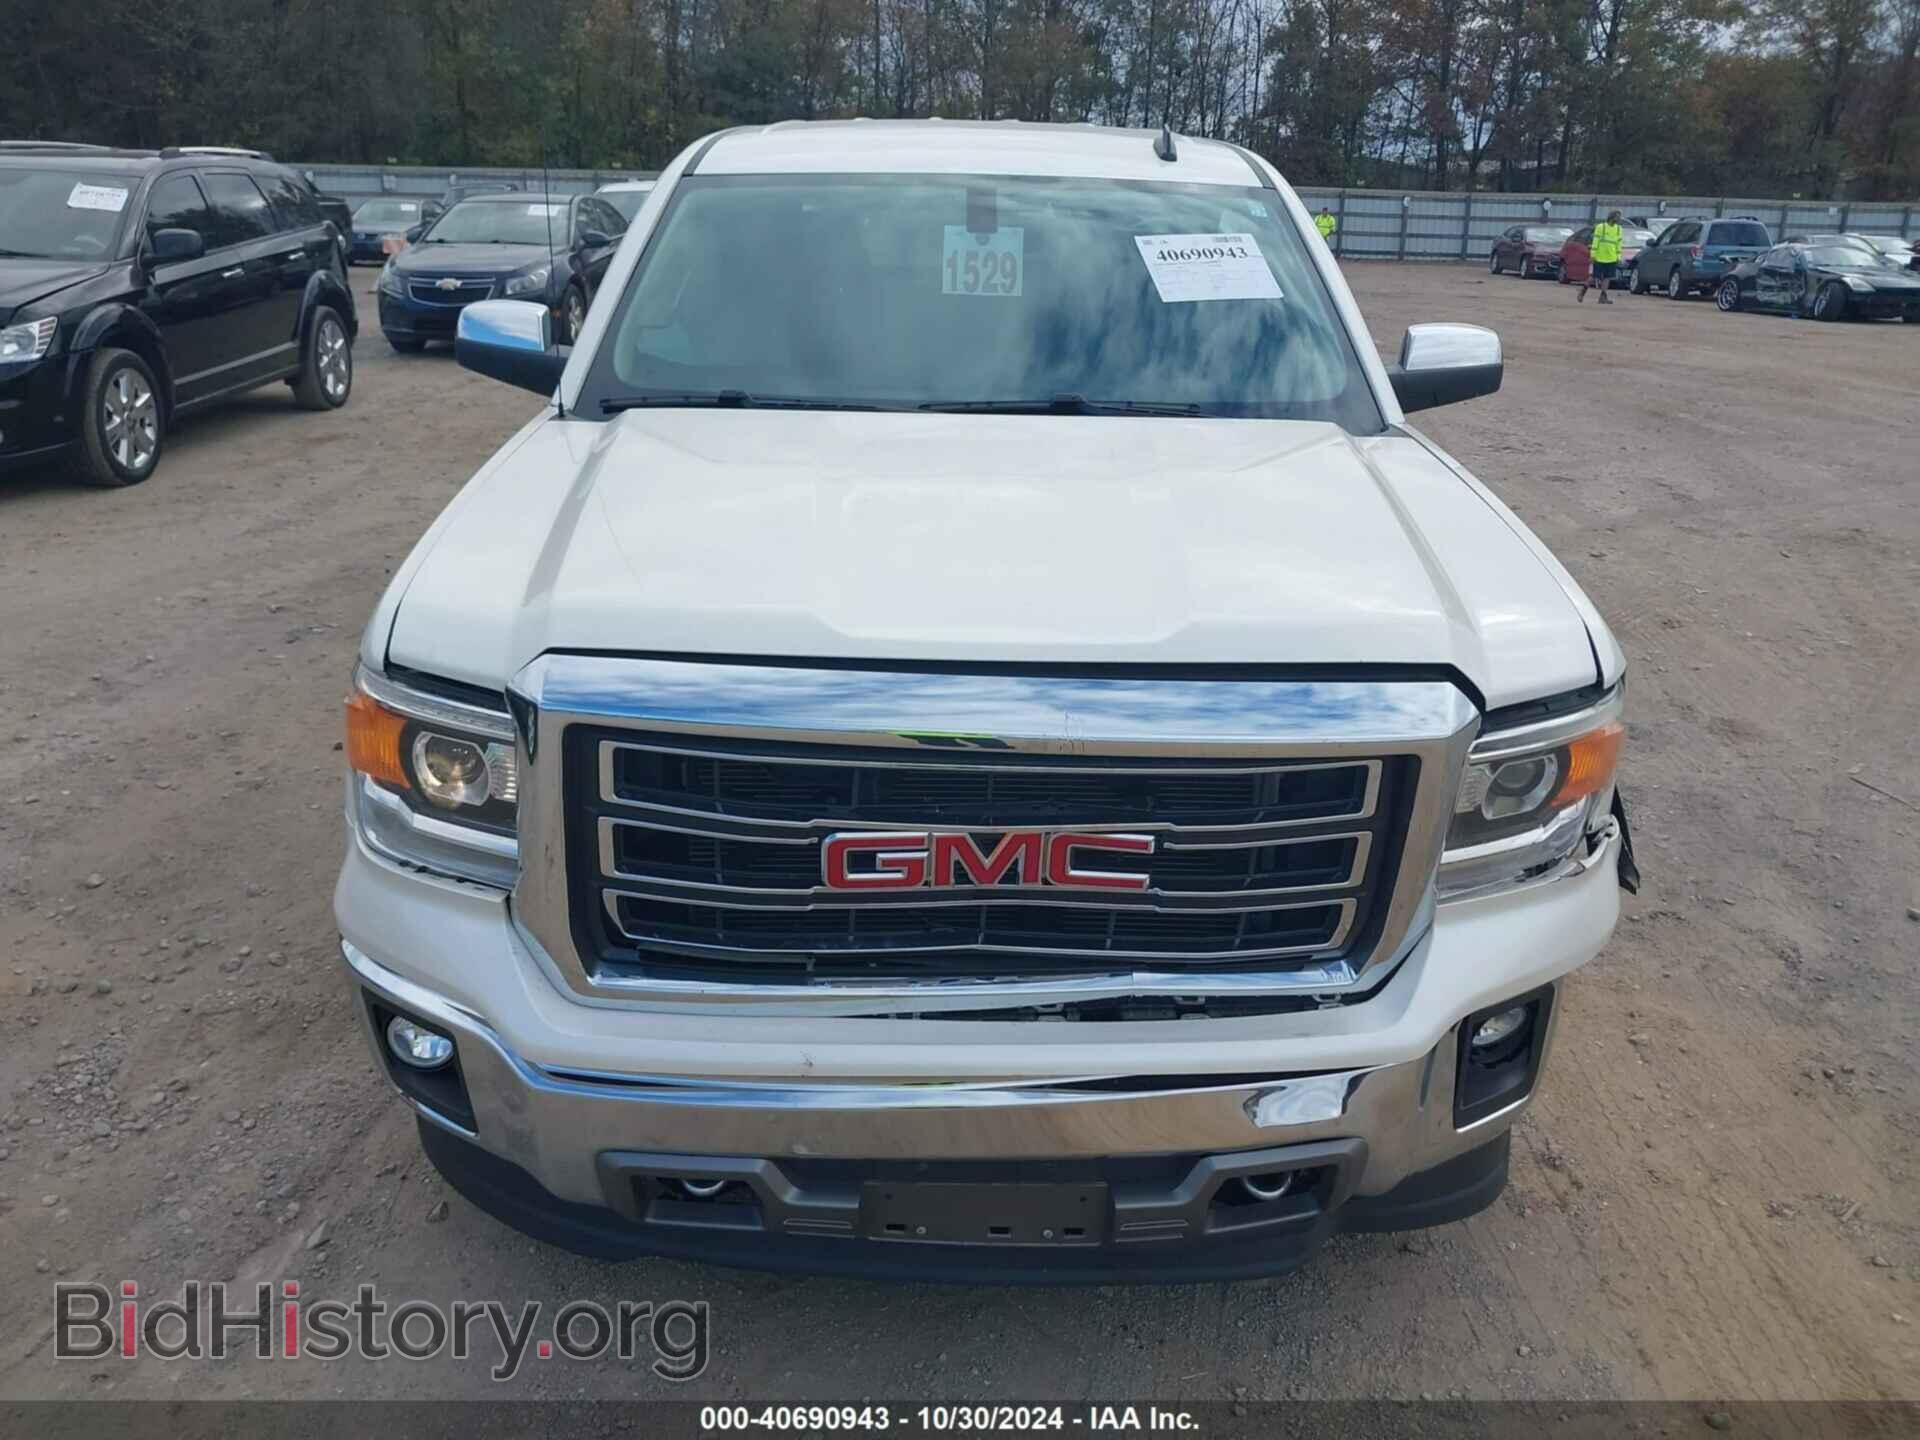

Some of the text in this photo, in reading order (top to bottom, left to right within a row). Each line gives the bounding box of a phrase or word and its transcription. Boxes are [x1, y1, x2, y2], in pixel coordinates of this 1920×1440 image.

[946, 249, 1018, 294] 1529
[1156, 247, 1248, 263] 40690943
[821, 831, 1155, 890] GMC
